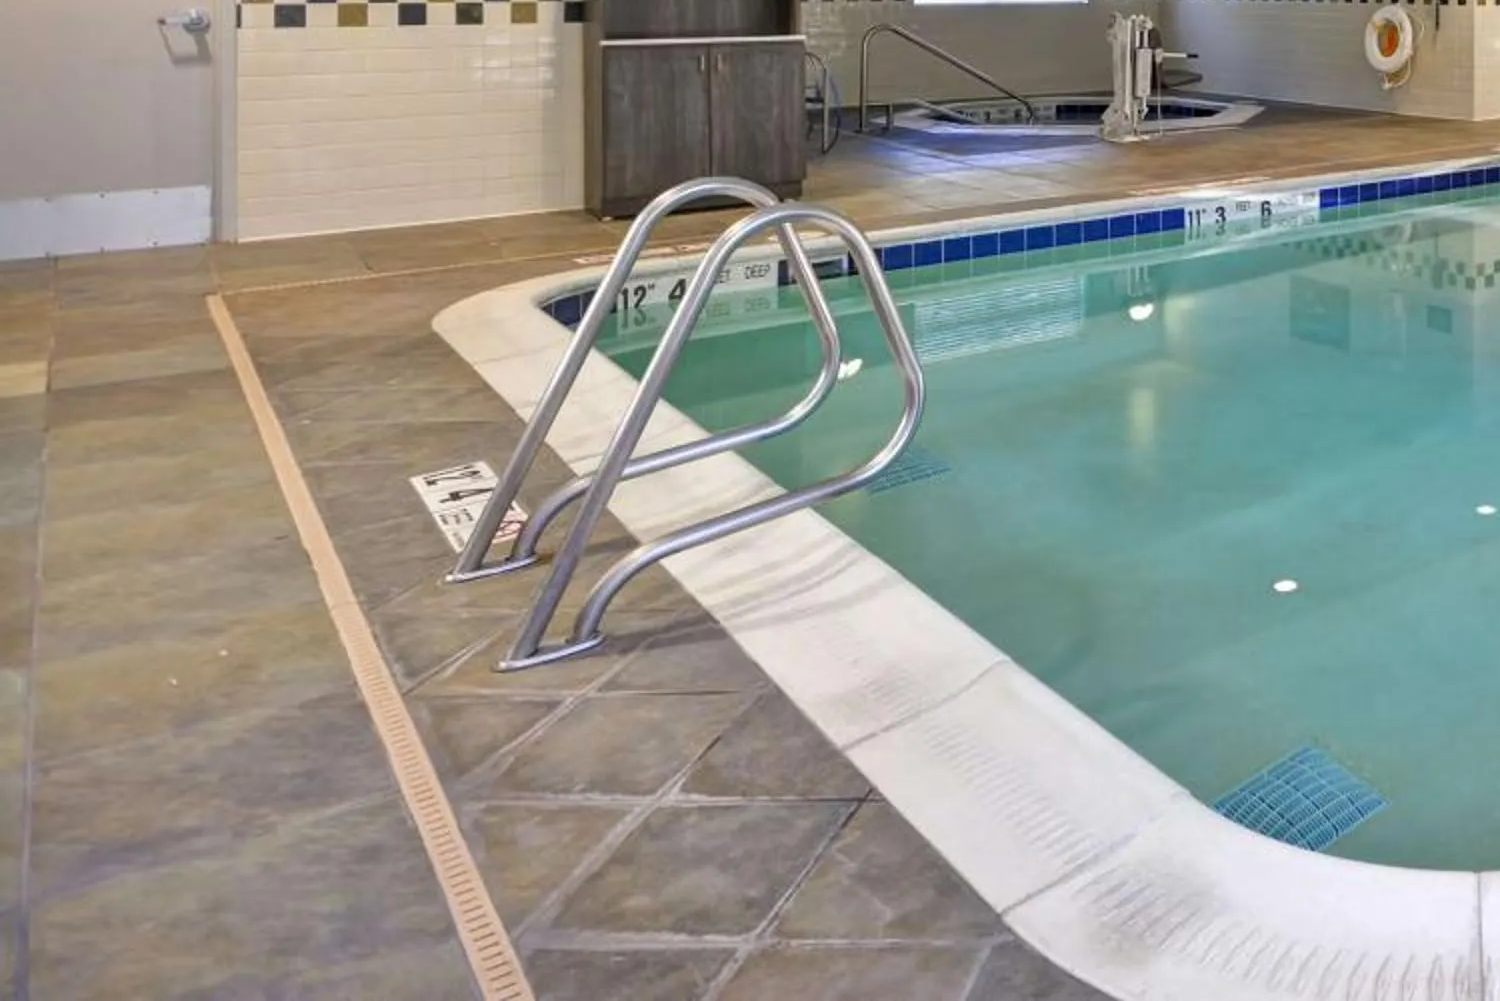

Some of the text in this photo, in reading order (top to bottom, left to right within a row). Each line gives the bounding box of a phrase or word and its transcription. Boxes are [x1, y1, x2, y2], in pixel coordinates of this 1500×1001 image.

[1215, 206, 1226, 224] 3
[744, 263, 771, 280] DEEP
[438, 487, 496, 504] 4
